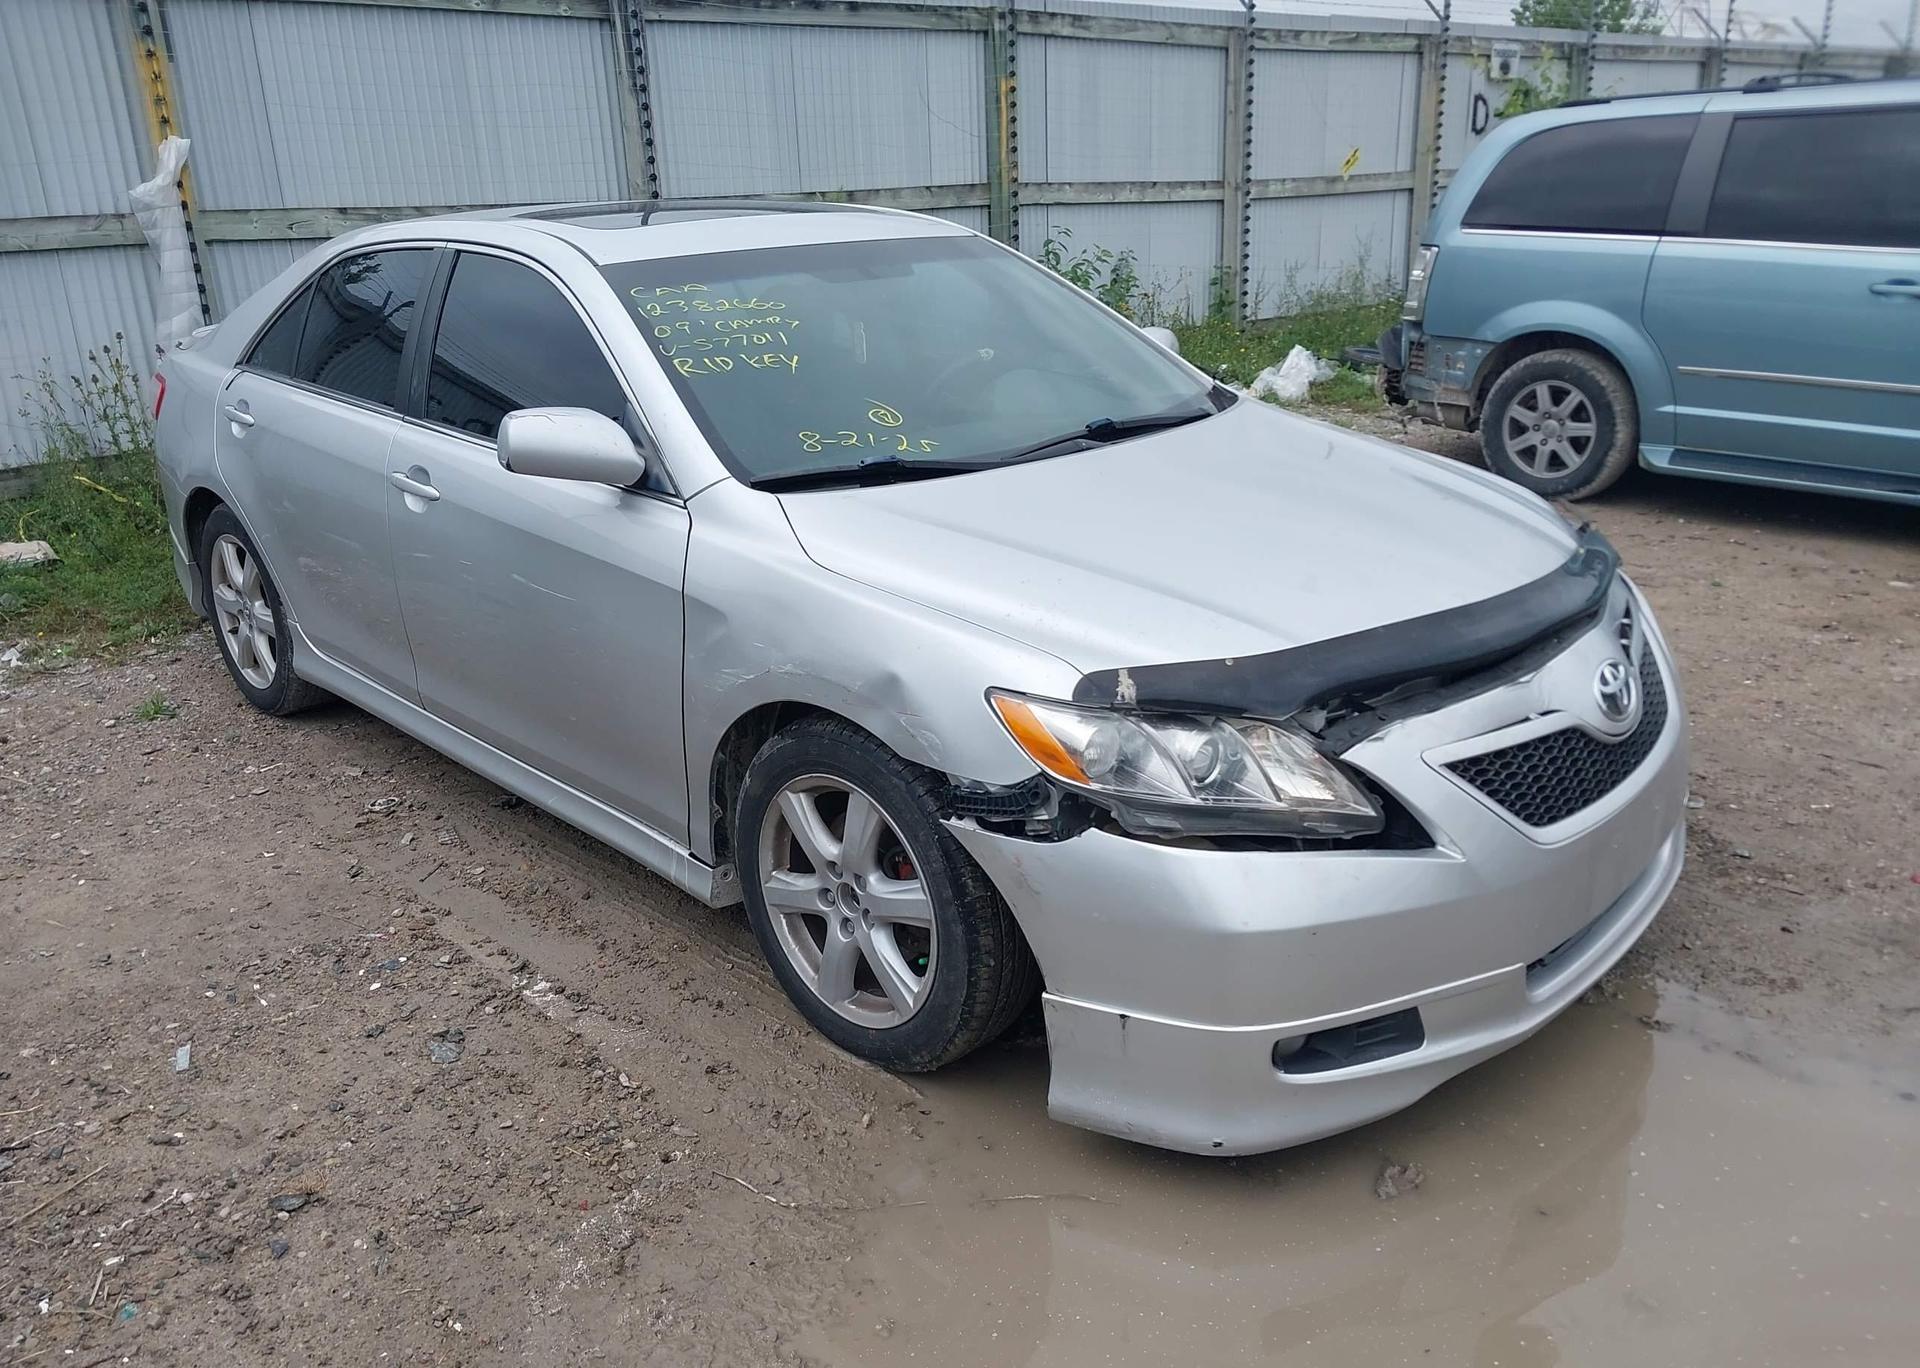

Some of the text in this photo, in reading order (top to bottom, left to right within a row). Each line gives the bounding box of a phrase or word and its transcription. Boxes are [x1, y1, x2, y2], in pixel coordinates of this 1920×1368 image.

[1471, 92, 1489, 136] D
[637, 298, 786, 319] 12382660
[740, 353, 799, 374] KEY
[799, 431, 940, 452] 8-21-25
